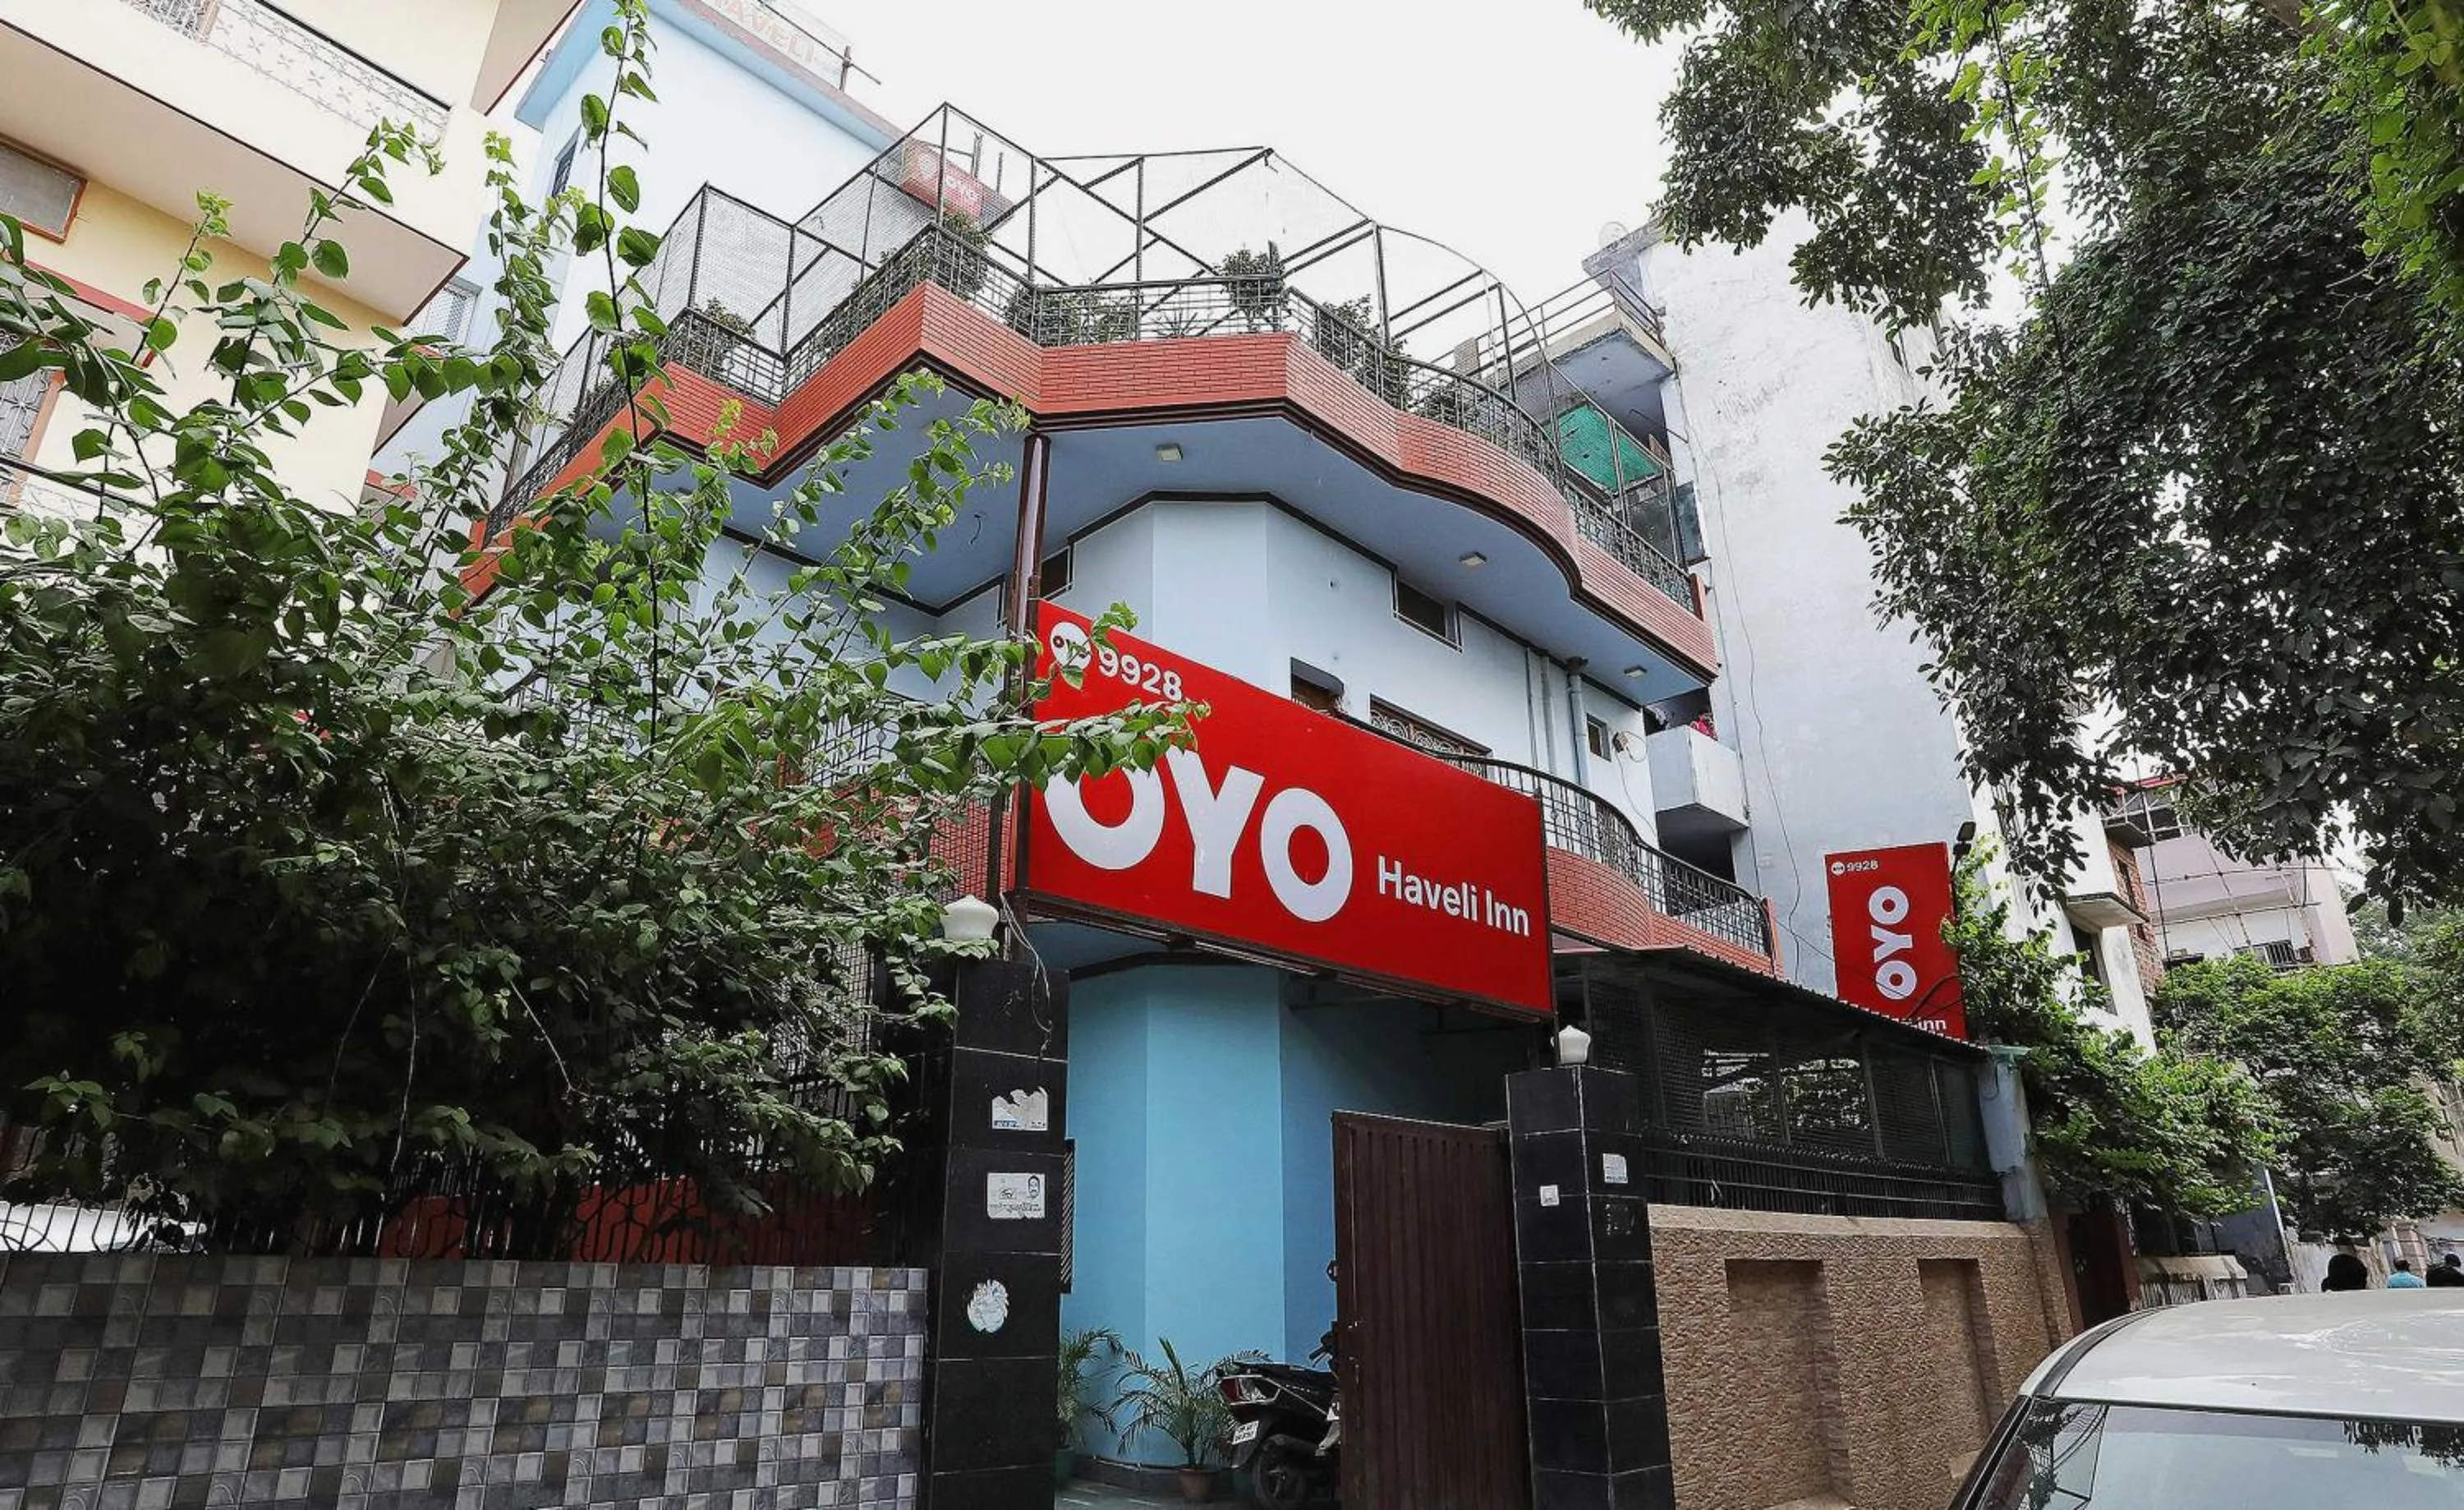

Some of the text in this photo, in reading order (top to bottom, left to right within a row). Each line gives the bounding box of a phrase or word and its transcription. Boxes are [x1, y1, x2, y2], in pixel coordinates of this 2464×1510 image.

[712, 0, 815, 62] AVELI
[1098, 646, 1183, 702] 9928
[1044, 744, 1354, 923] OYO
[1378, 854, 1530, 937] Haveli Inn
[1869, 886, 1917, 1000] OYO
